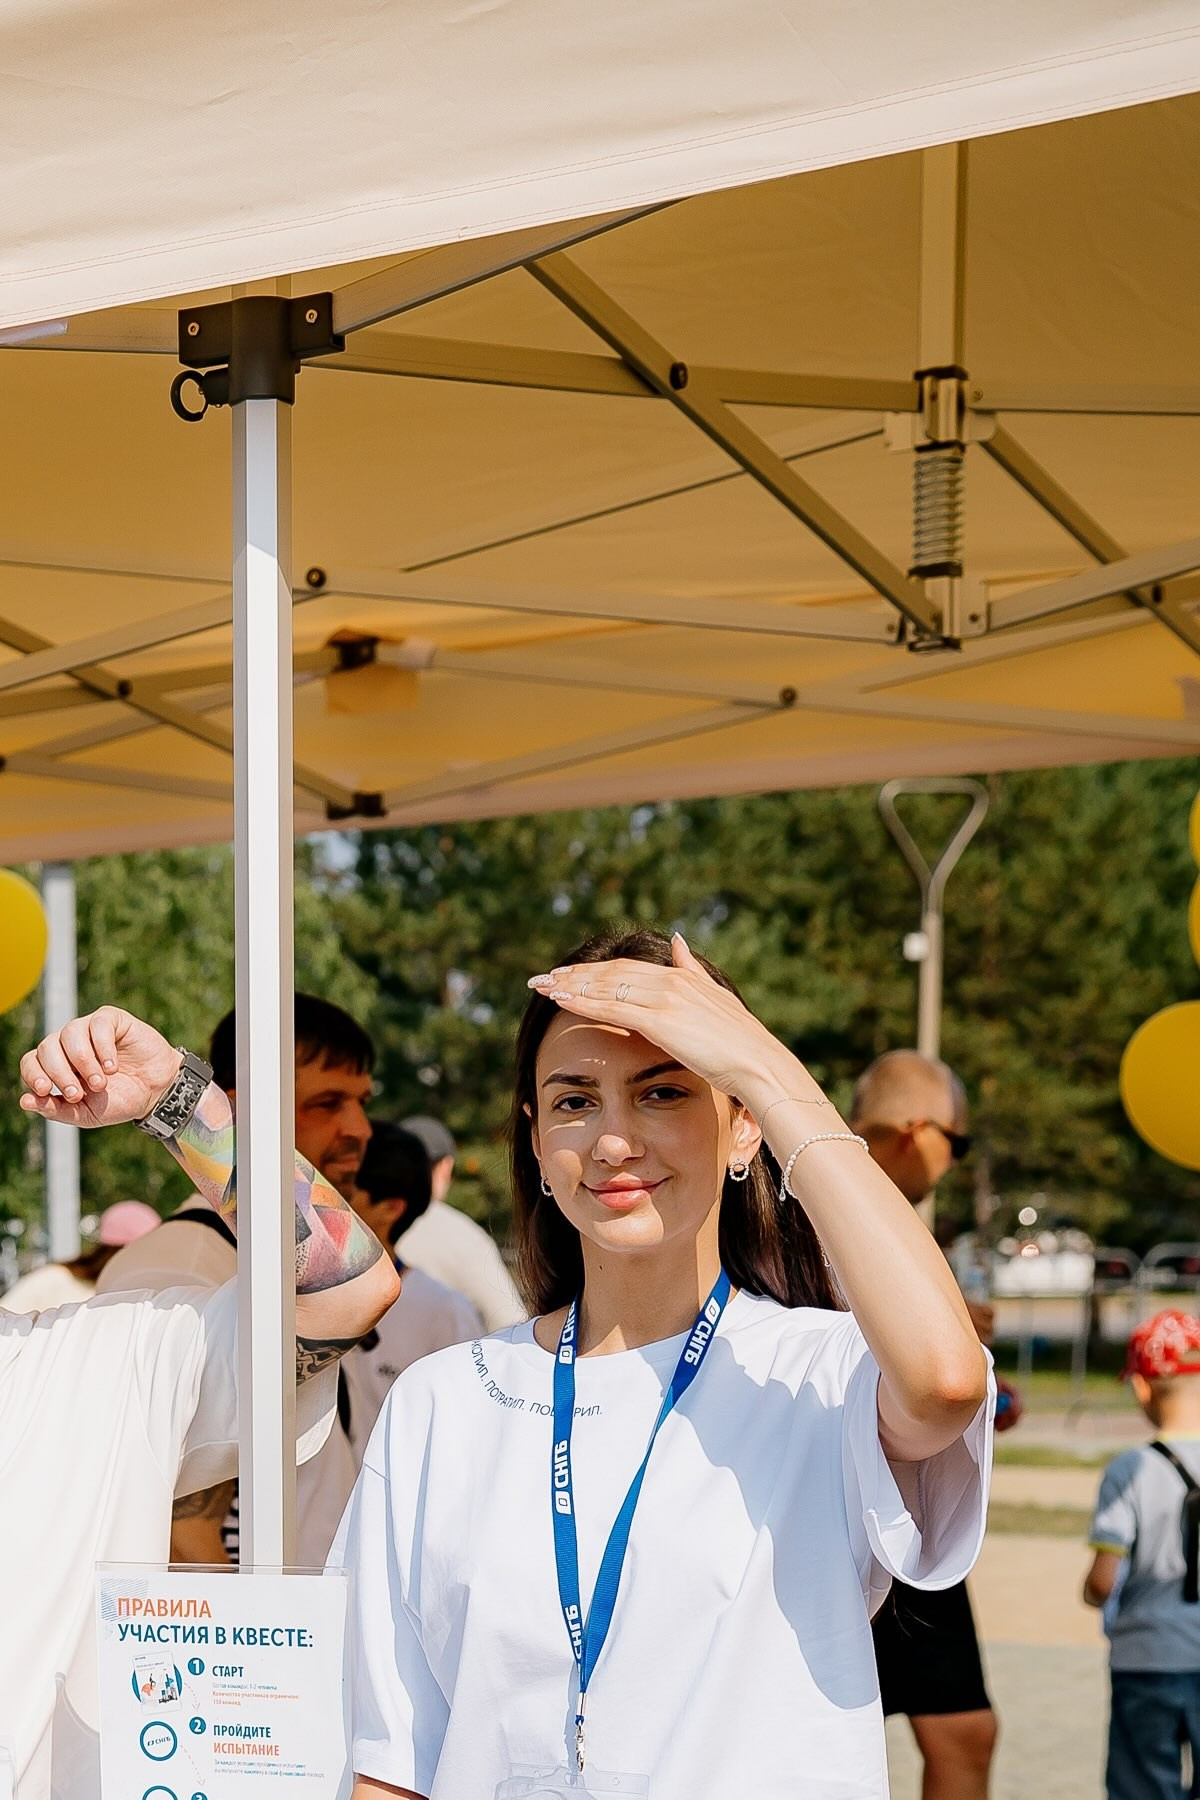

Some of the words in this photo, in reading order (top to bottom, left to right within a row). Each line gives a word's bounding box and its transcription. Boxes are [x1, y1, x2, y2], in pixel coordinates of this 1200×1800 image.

[684, 1321, 713, 1366] СНГБ
[555, 1440, 569, 1489] СНГБ
[117, 1597, 212, 1618] ПРАВИЛА
[118, 1624, 209, 1644] УЧАСТИЯ
[215, 1627, 227, 1645] В
[233, 1627, 314, 1647] КВЕСТЕ:
[565, 1604, 582, 1660] СНГБ
[191, 1660, 200, 1673] 1
[212, 1665, 244, 1678] СТАРТ
[194, 1719, 202, 1732] 2
[213, 1723, 271, 1739] ПРОЙДИТЕ
[213, 1742, 280, 1756] ИСПЫТАНИЕ
